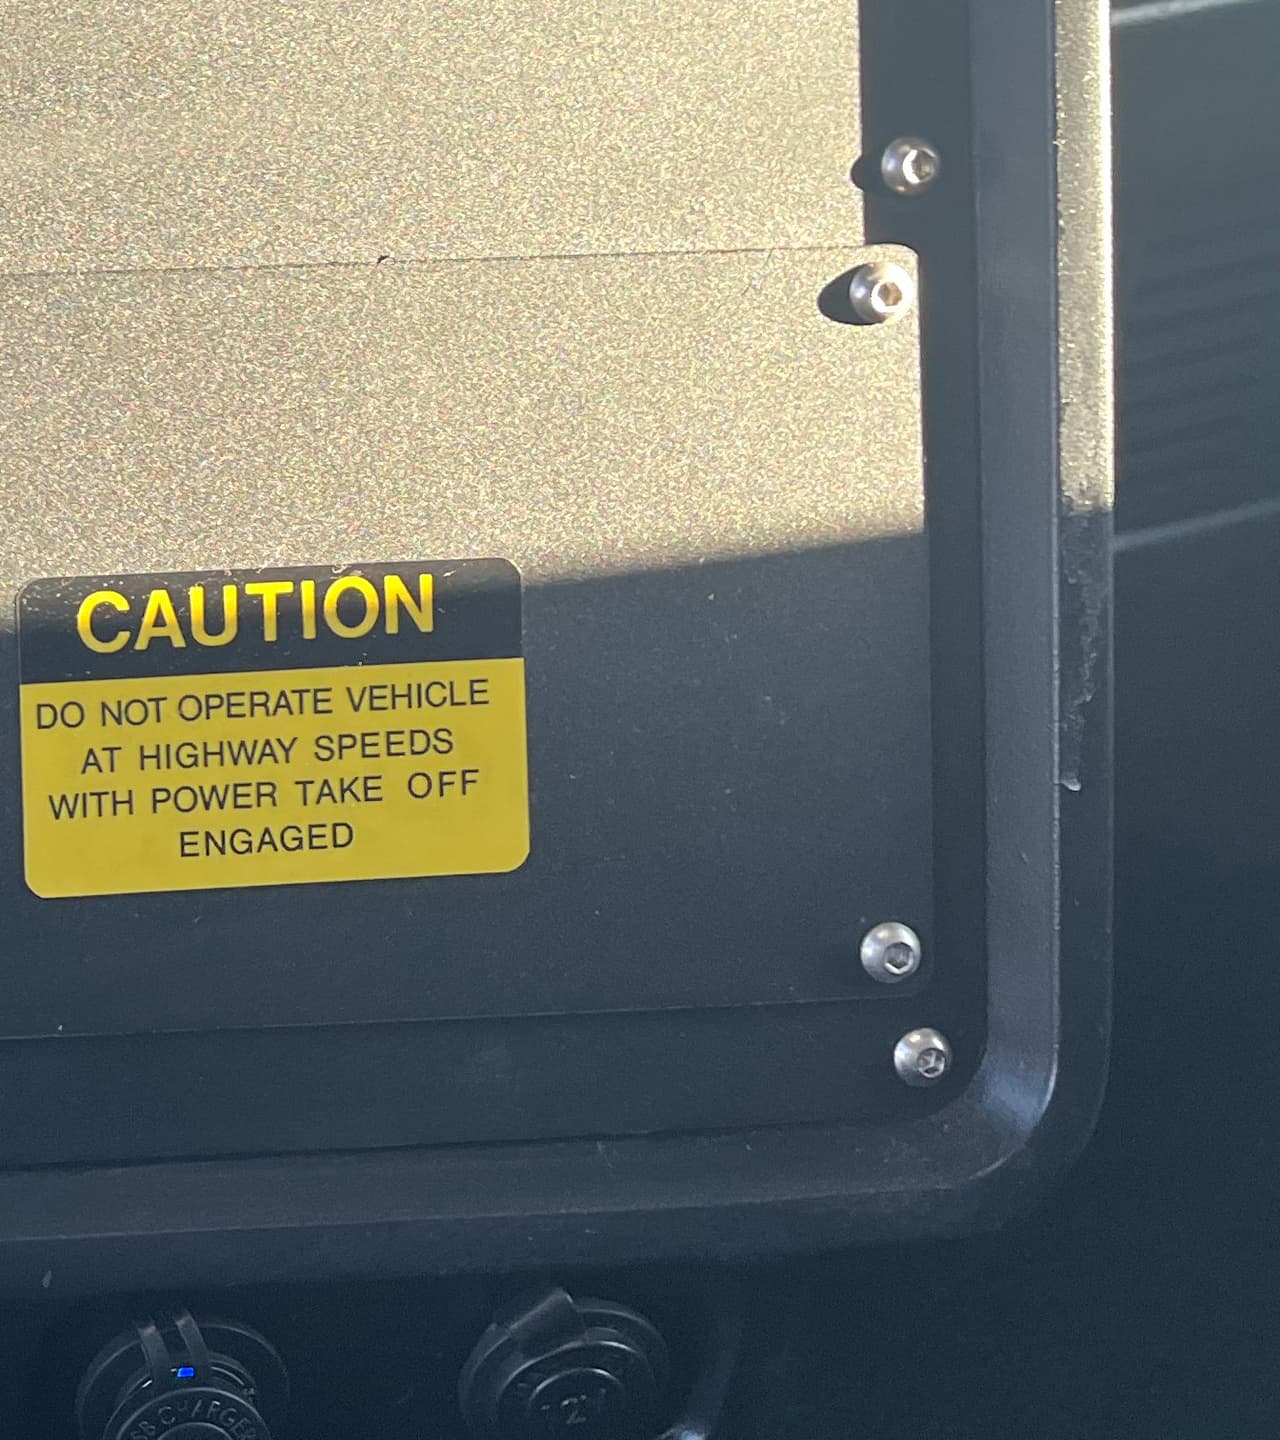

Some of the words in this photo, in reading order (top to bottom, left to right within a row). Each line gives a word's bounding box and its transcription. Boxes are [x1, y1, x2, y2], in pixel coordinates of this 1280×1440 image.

[76, 573, 434, 654] CAUTION
[37, 701, 85, 729] DO
[101, 697, 167, 726] NOT
[179, 687, 333, 721] OPERATE
[347, 679, 489, 713] VEHICLE
[81, 746, 121, 774] AT
[140, 737, 298, 770] HIGHWAY
[315, 728, 454, 761] SPEEDS
[49, 790, 134, 819] WITH
[152, 782, 277, 813] POWER
[295, 776, 383, 806] TAKE
[407, 769, 479, 799] OFF
[180, 822, 354, 857] ENGAGED
